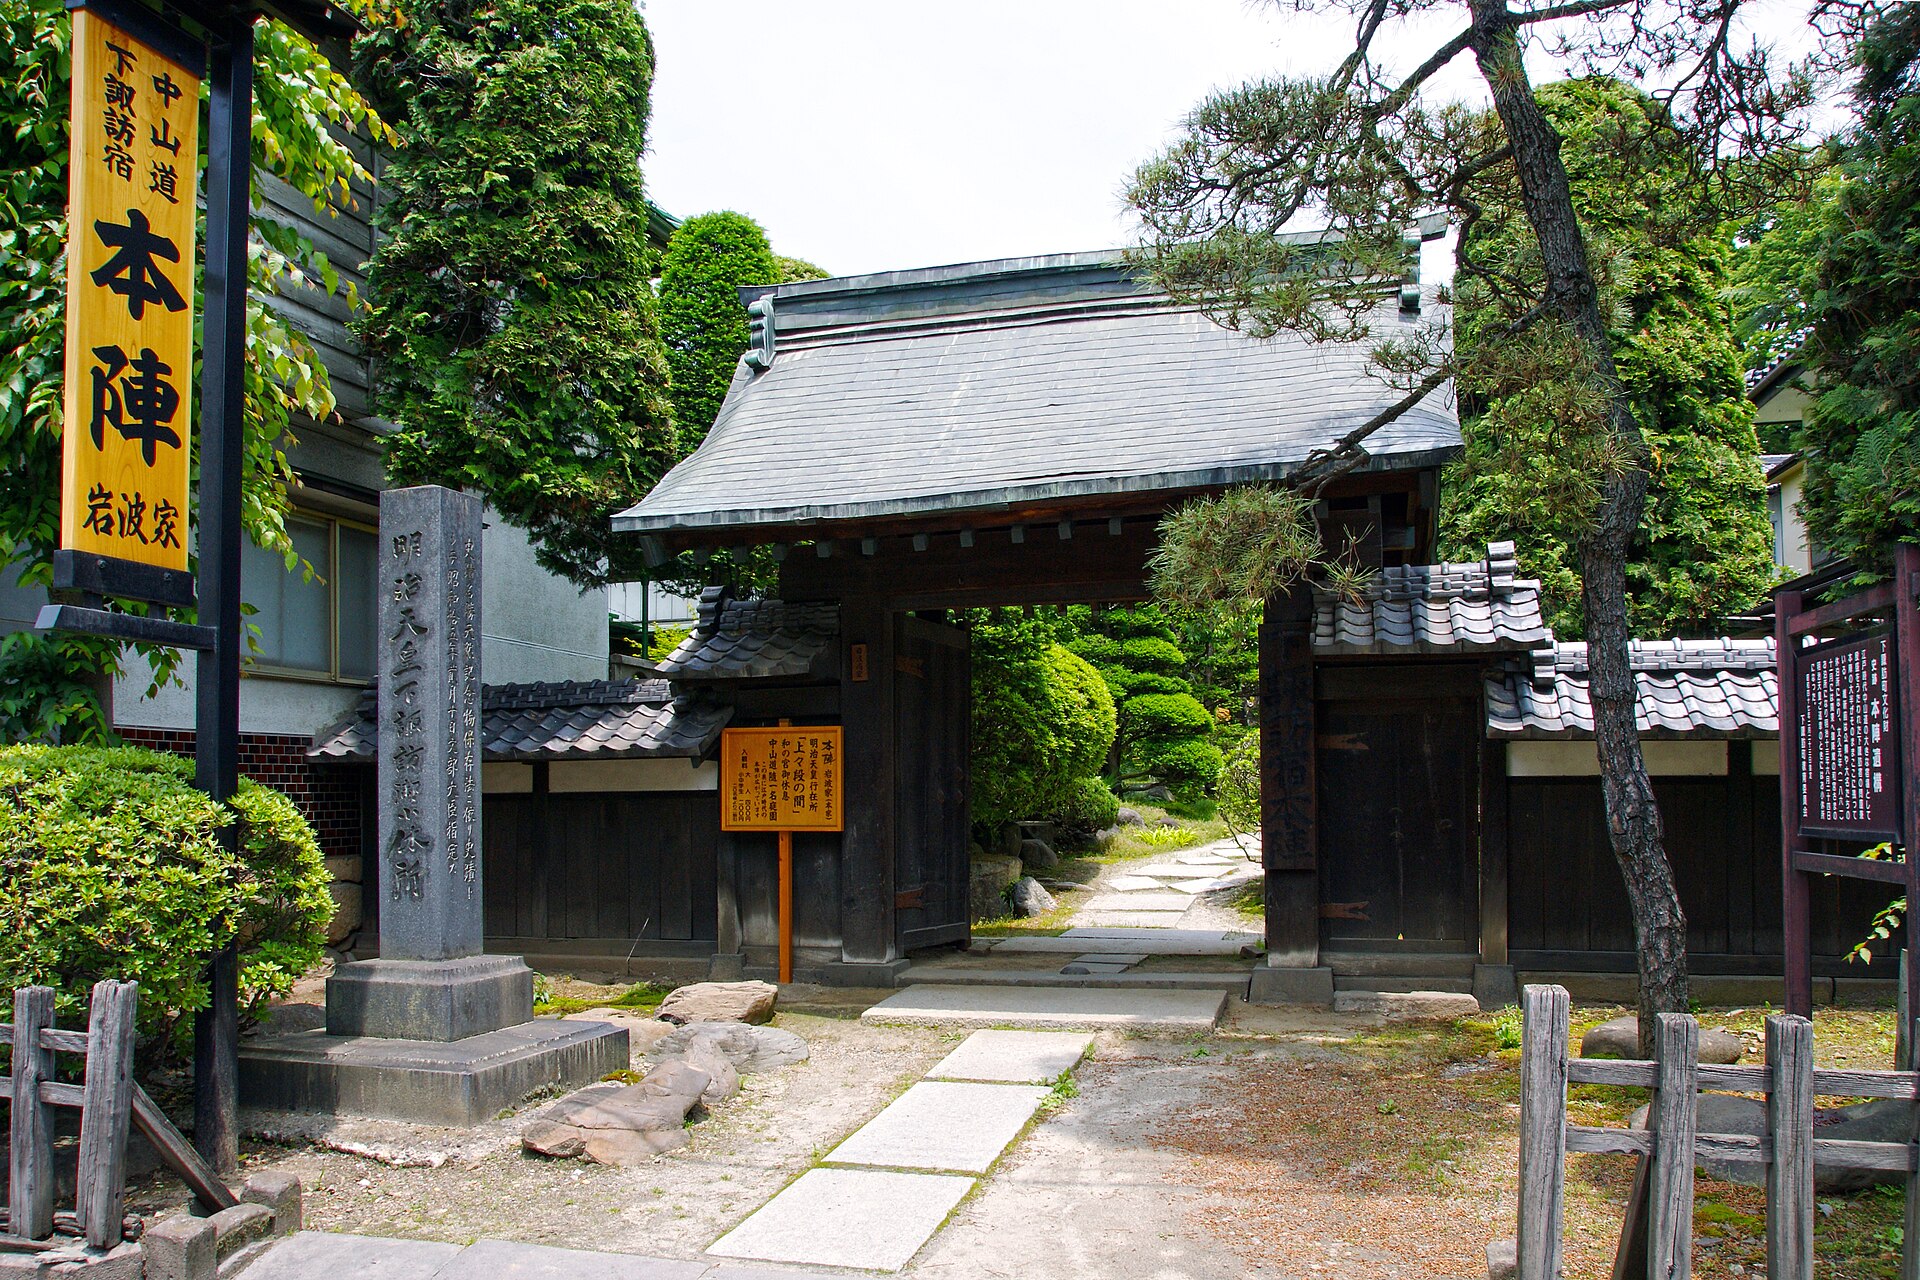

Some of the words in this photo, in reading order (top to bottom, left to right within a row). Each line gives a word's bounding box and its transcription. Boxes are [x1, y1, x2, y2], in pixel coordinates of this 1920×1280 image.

[103, 41, 138, 183] 下諏訪宿
[149, 72, 184, 204] 中山道
[89, 208, 189, 469] 本陣
[82, 482, 182, 550] 岩波家
[781, 738, 791, 801] 和の宮御休息
[792, 736, 806, 814] 「上々段の間」
[809, 738, 818, 812] 明治天皇行在所
[821, 740, 836, 765] 本陣
